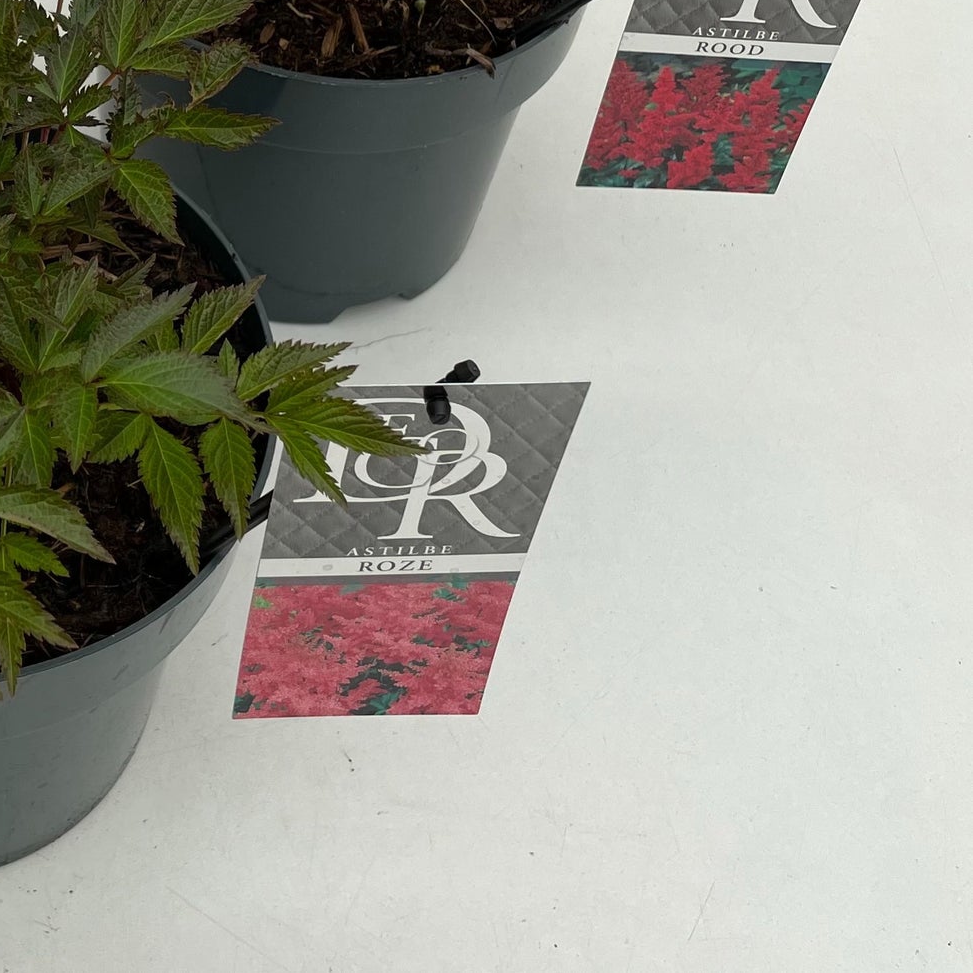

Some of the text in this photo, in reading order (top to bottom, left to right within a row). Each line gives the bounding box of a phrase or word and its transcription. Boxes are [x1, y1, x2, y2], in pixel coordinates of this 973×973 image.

[692, 27, 780, 41] ASTILBE
[696, 41, 764, 56] ROOD
[346, 545, 453, 556] ASTILBE
[357, 559, 433, 572] ROZE
